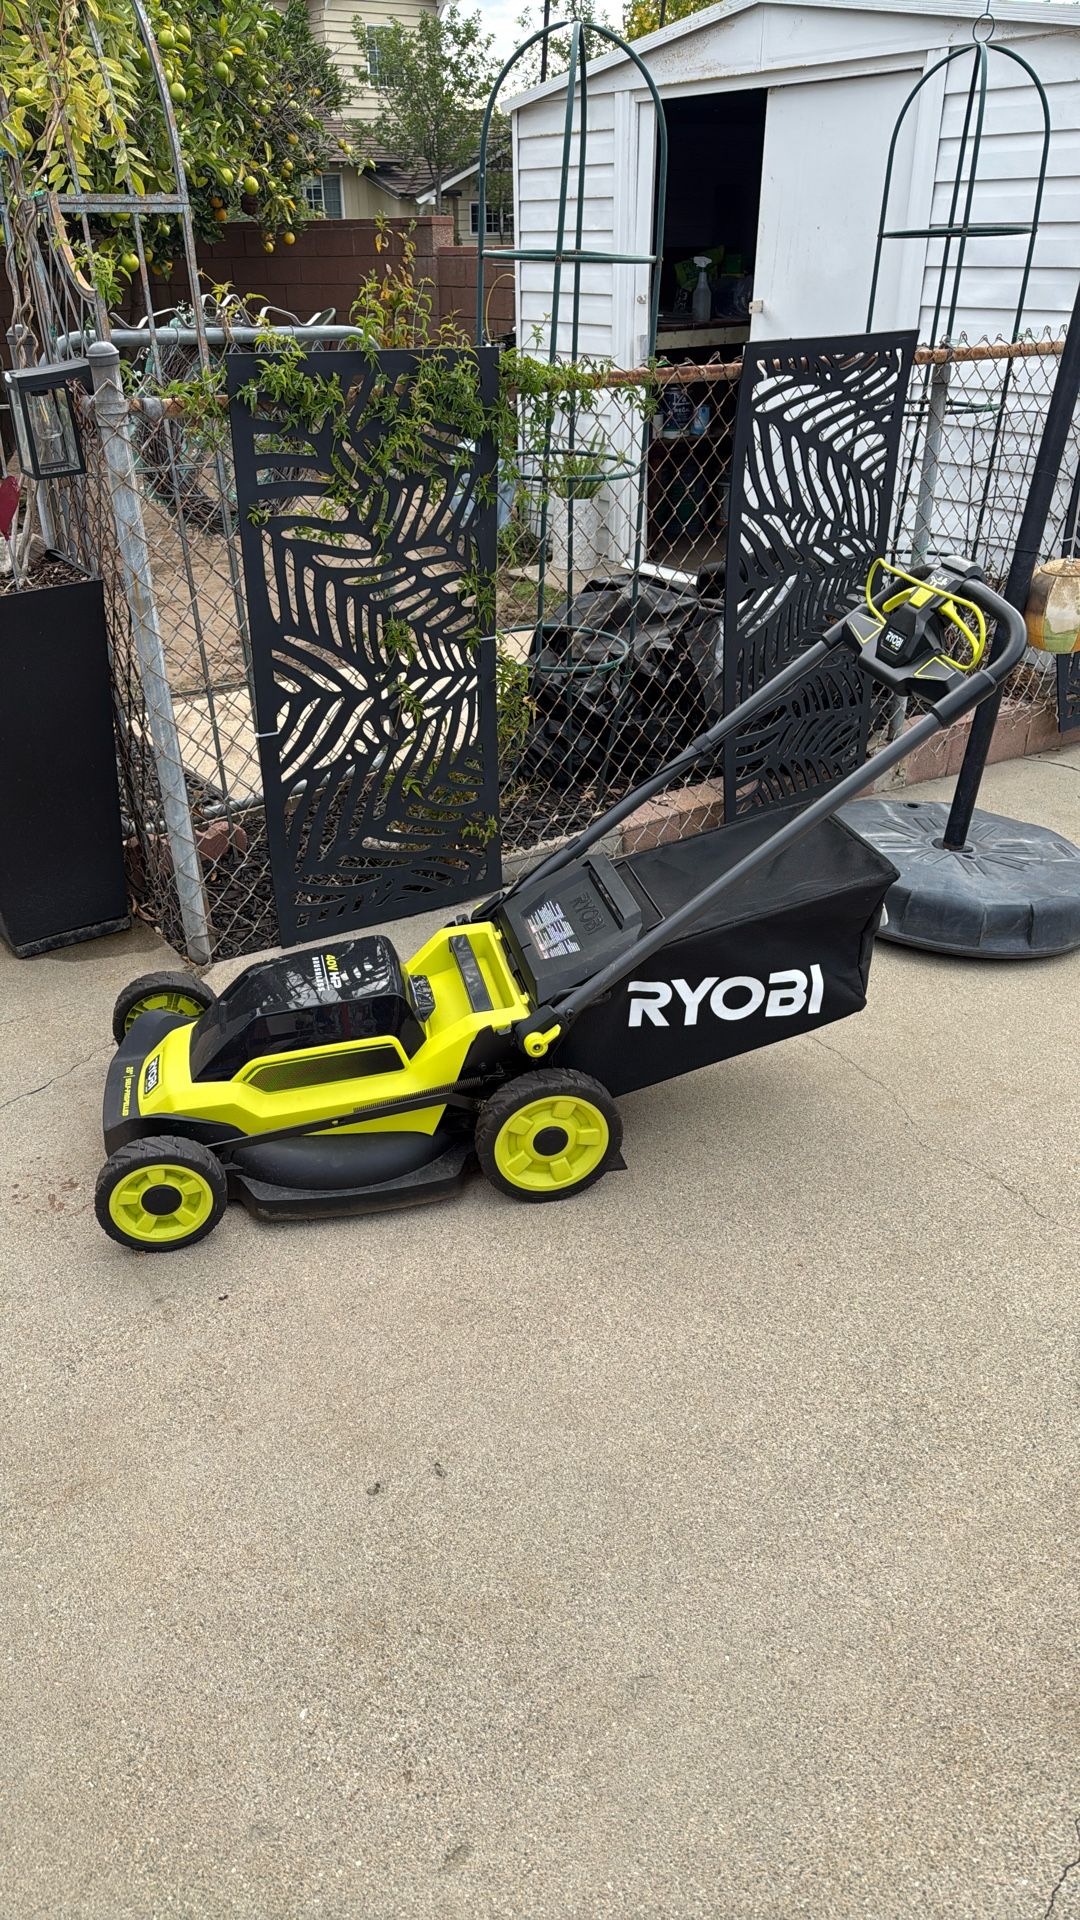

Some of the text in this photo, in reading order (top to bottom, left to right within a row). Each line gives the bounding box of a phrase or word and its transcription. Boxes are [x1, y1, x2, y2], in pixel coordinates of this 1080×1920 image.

[885, 631, 904, 648] RYOBI
[571, 892, 607, 936] RYOBI
[325, 954, 342, 989] 40V HP
[627, 963, 825, 1028] RYOBI
